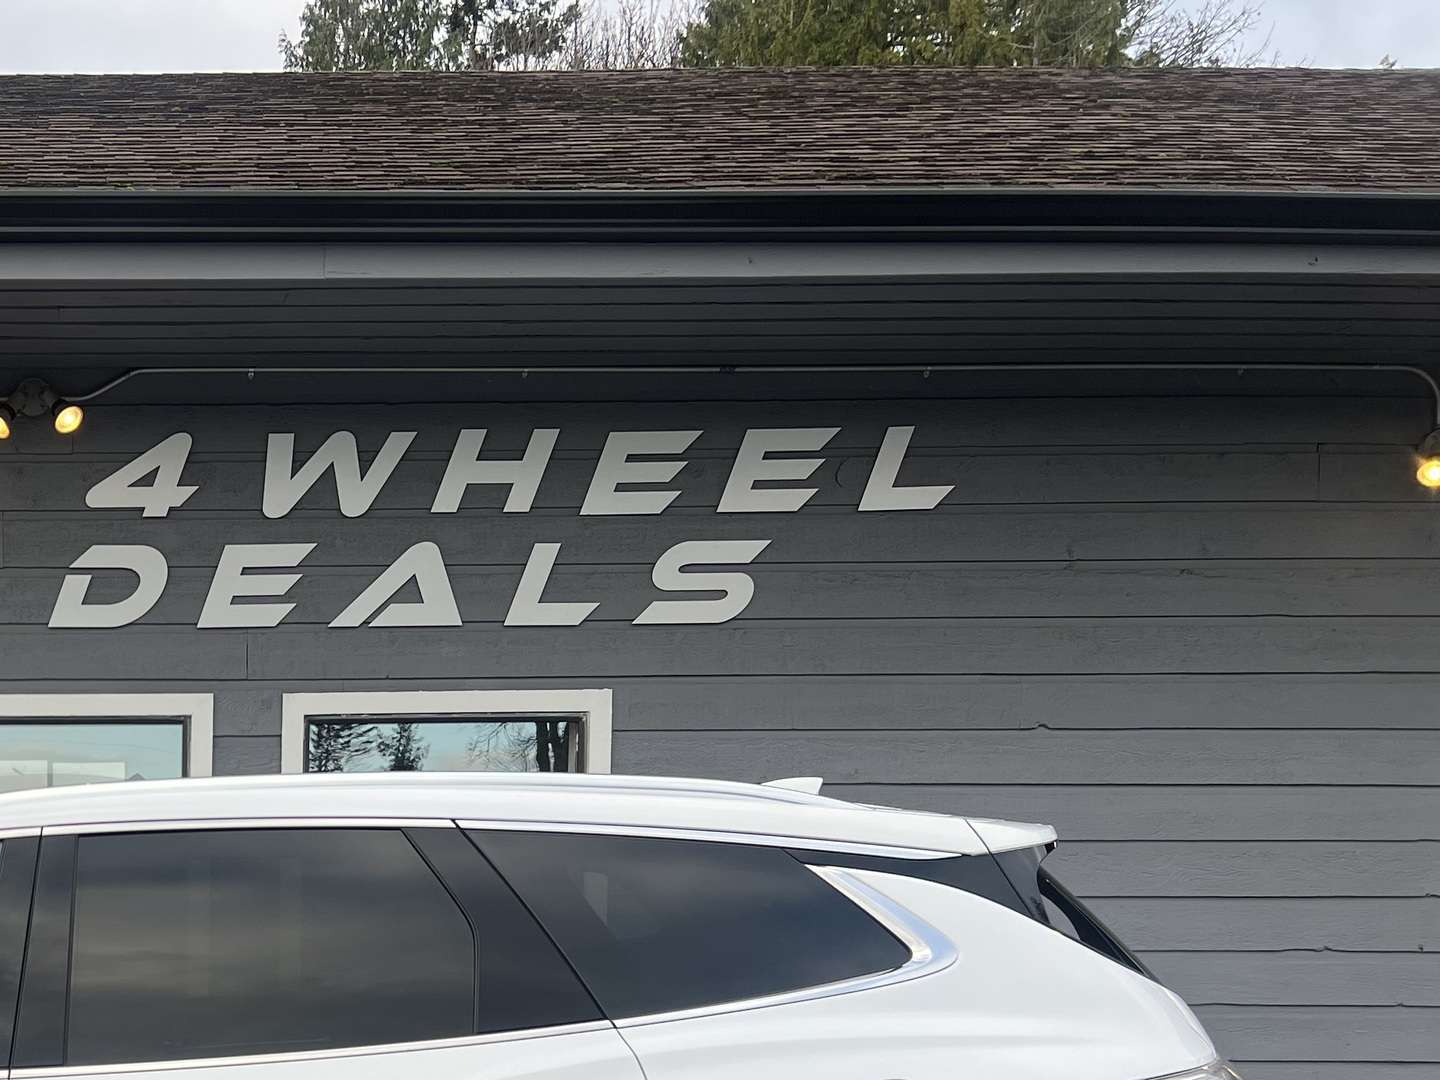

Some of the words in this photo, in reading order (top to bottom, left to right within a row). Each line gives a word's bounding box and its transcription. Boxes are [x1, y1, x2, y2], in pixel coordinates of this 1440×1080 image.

[85, 432, 199, 518] 4
[261, 425, 956, 519] WHEEL
[48, 539, 772, 629] DEALS
